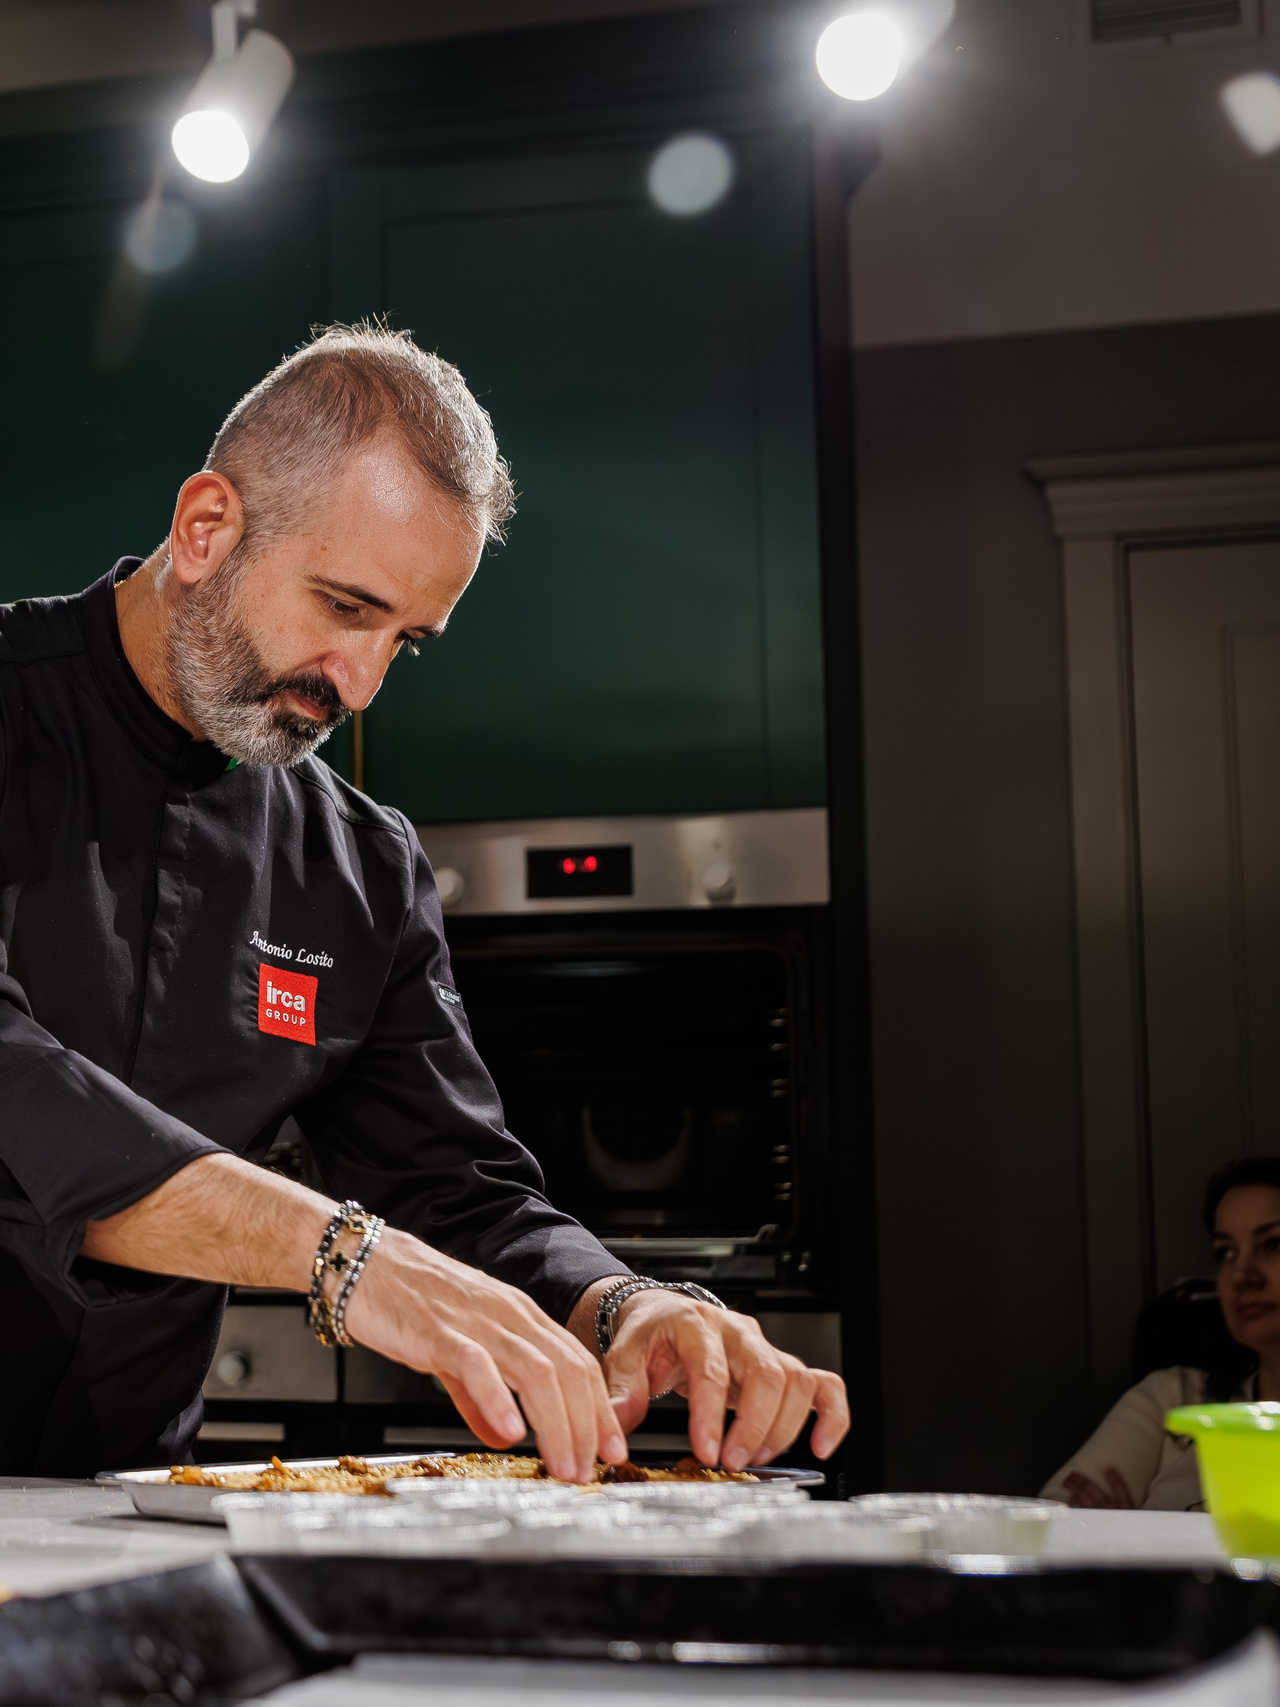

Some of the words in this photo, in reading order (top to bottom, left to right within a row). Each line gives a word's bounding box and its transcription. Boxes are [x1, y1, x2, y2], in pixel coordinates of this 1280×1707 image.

[250, 930, 293, 960] Antonio
[295, 948, 334, 968] Losito
[266, 980, 306, 1012] irca
[265, 1008, 306, 1027] GROUP
